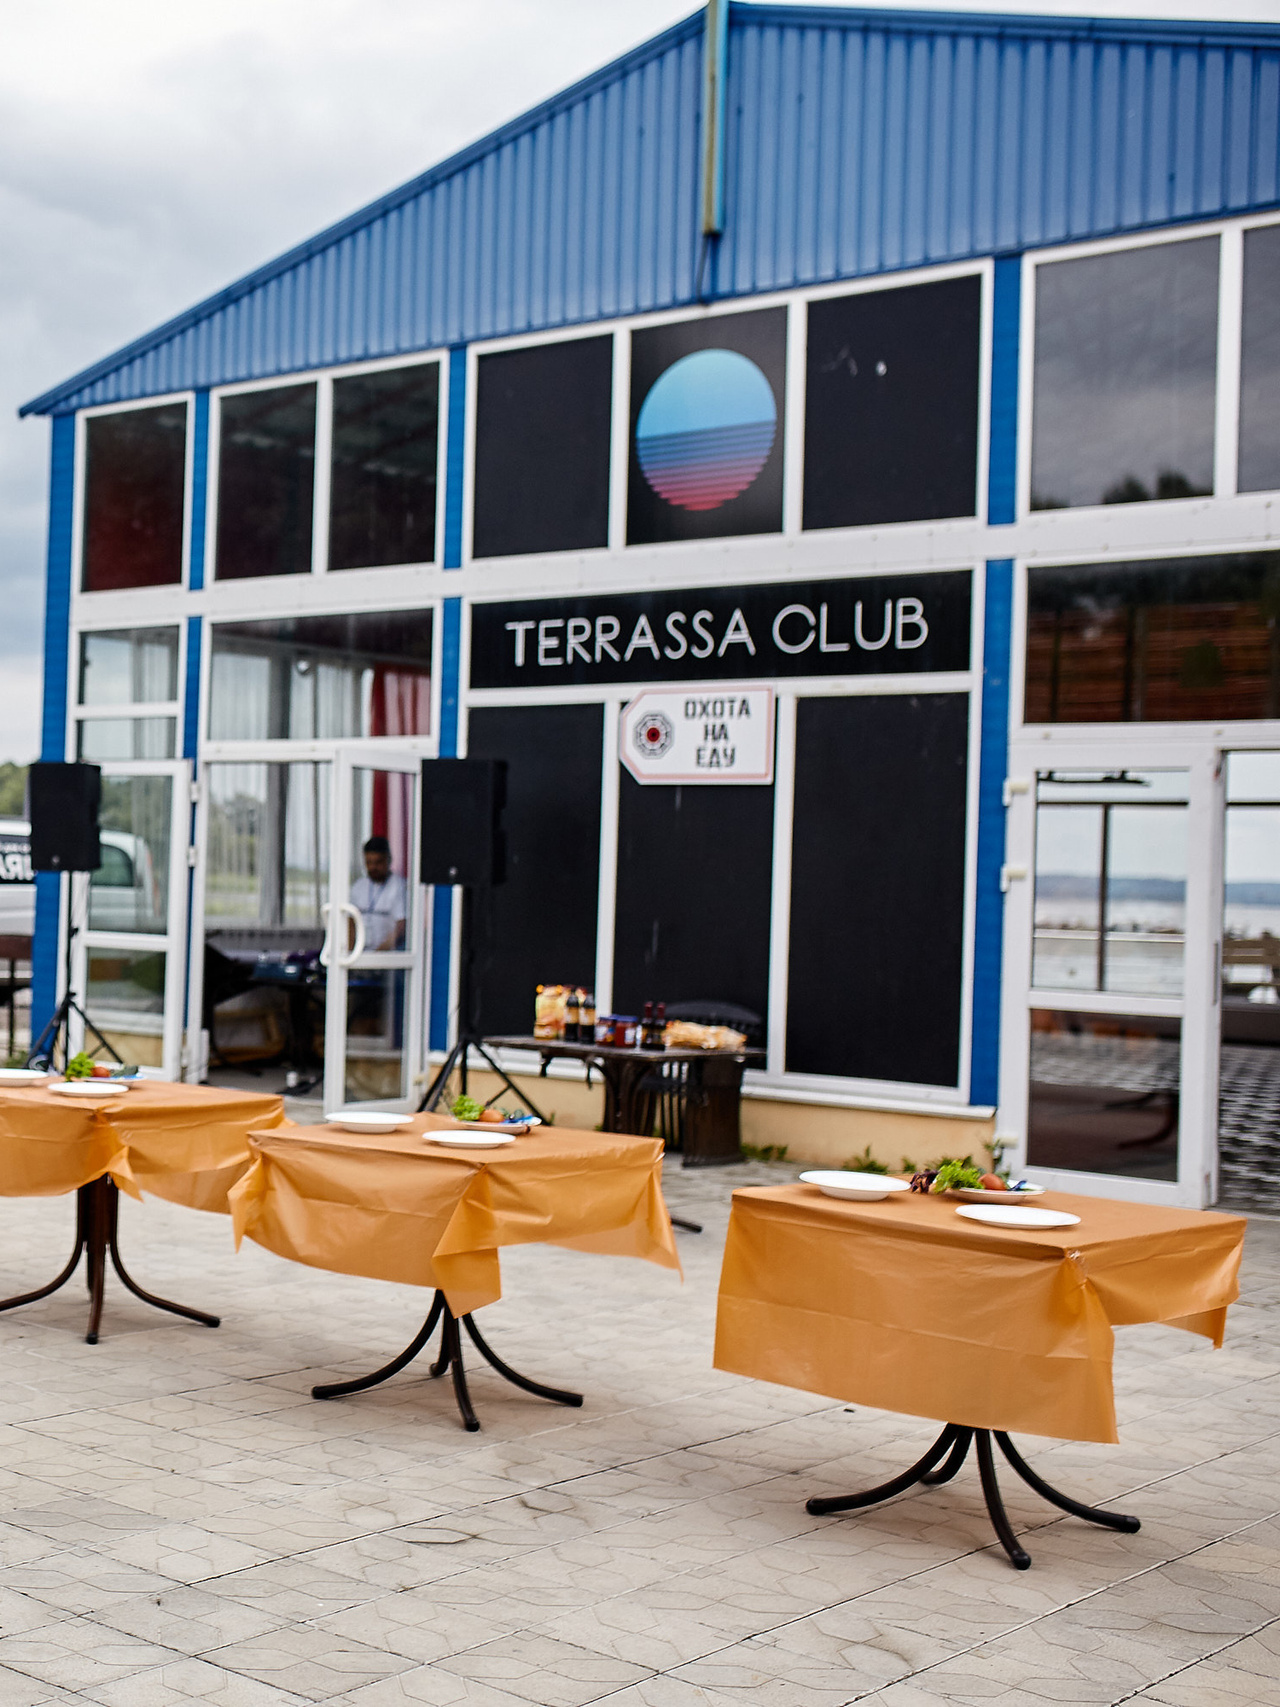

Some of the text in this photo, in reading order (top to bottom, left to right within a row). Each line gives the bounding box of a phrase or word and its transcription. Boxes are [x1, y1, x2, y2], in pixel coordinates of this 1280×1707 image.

[505, 597, 929, 666] TERRASSA CLUB
[684, 697, 751, 719] ОХОТА
[703, 722, 729, 742] НА
[696, 746, 736, 768] ЕДУ
